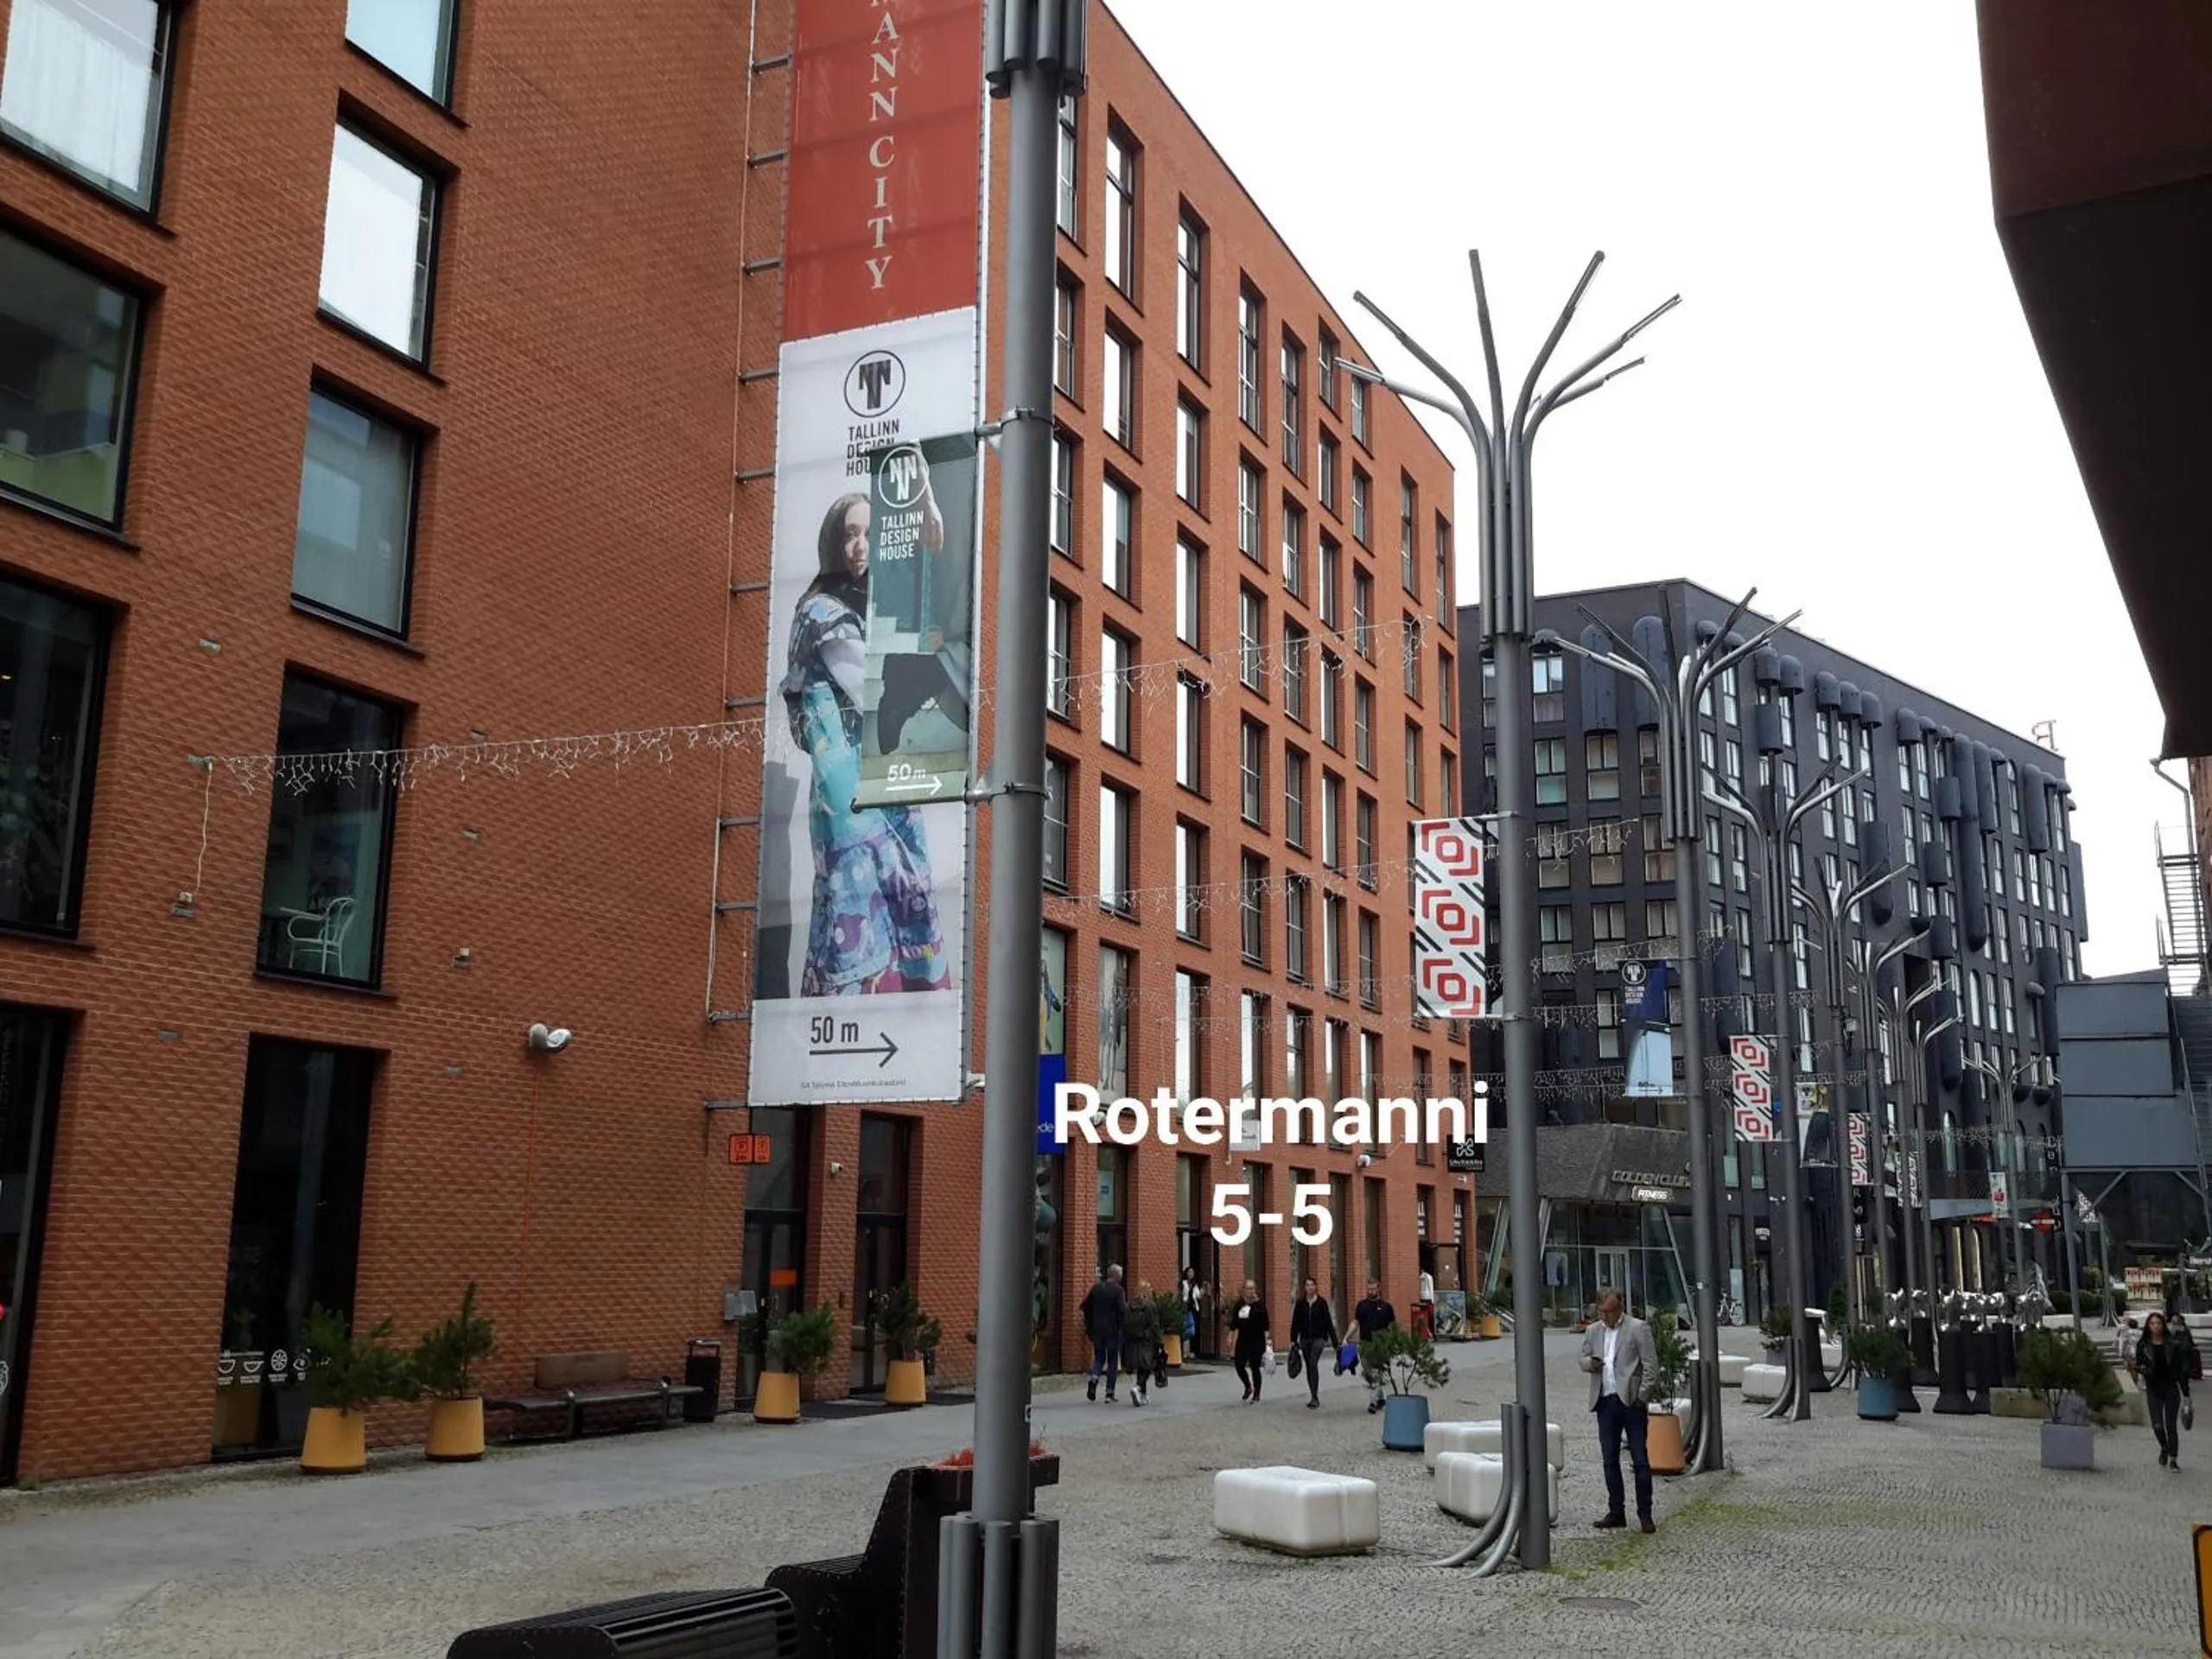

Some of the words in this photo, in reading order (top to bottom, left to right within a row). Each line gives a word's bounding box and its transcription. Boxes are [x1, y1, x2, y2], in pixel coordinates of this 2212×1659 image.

[868, 0, 899, 122] ANN
[865, 135, 895, 290] CITY
[848, 418, 900, 442] TALLINN
[845, 457, 871, 478] HOU
[880, 511, 925, 530] TALLINN
[880, 527, 920, 546] DESIGN
[879, 543, 916, 562] HOUSE
[810, 1015, 834, 1044] 50
[841, 1021, 859, 1043] m
